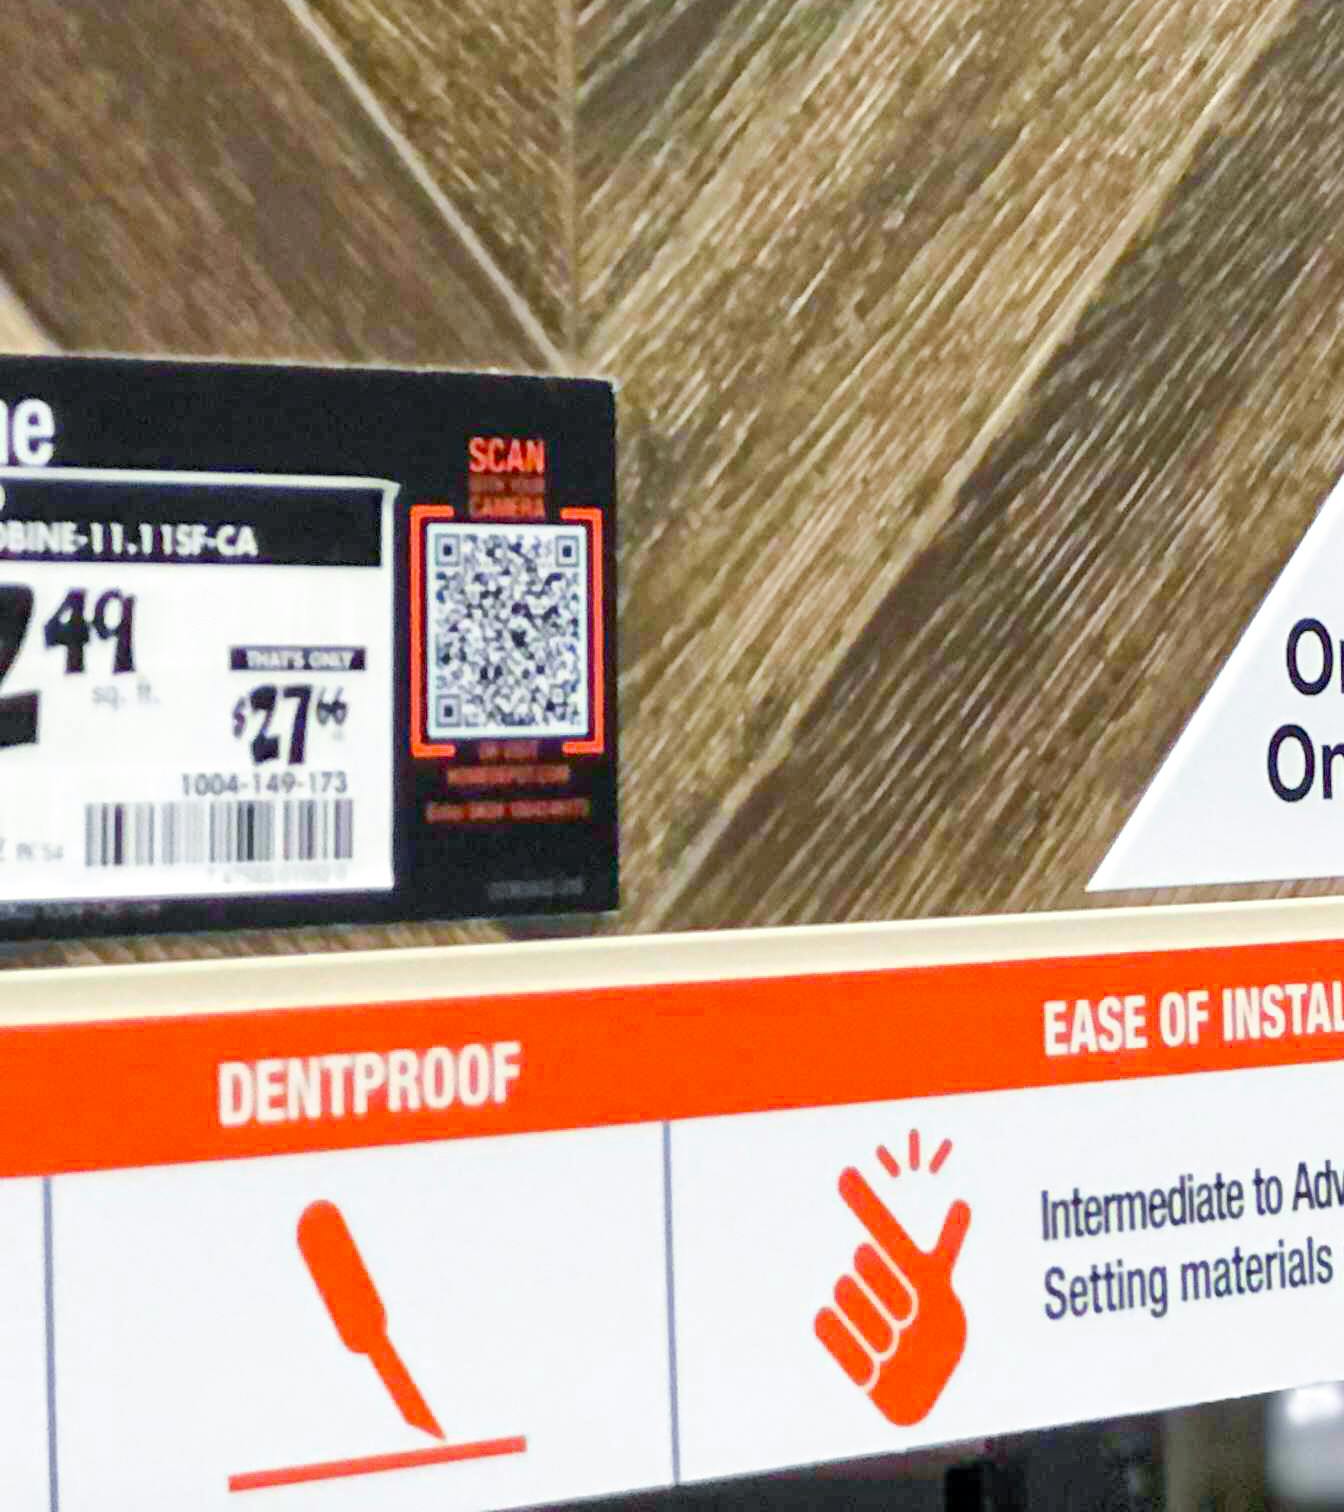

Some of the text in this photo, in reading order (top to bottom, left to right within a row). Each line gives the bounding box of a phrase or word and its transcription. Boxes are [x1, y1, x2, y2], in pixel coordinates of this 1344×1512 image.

[0, 398, 55, 466] e
[469, 437, 545, 473] SCAN
[181, 772, 348, 796] 1004-149-173
[1043, 994, 1147, 1057] EASE
[1159, 990, 1209, 1046] OF
[218, 1040, 522, 1128] DENTPROOF
[1040, 1172, 1245, 1242] Intermediate
[1253, 1169, 1285, 1217] to
[1044, 1259, 1169, 1321] Setting
[1179, 1236, 1334, 1304] materials
